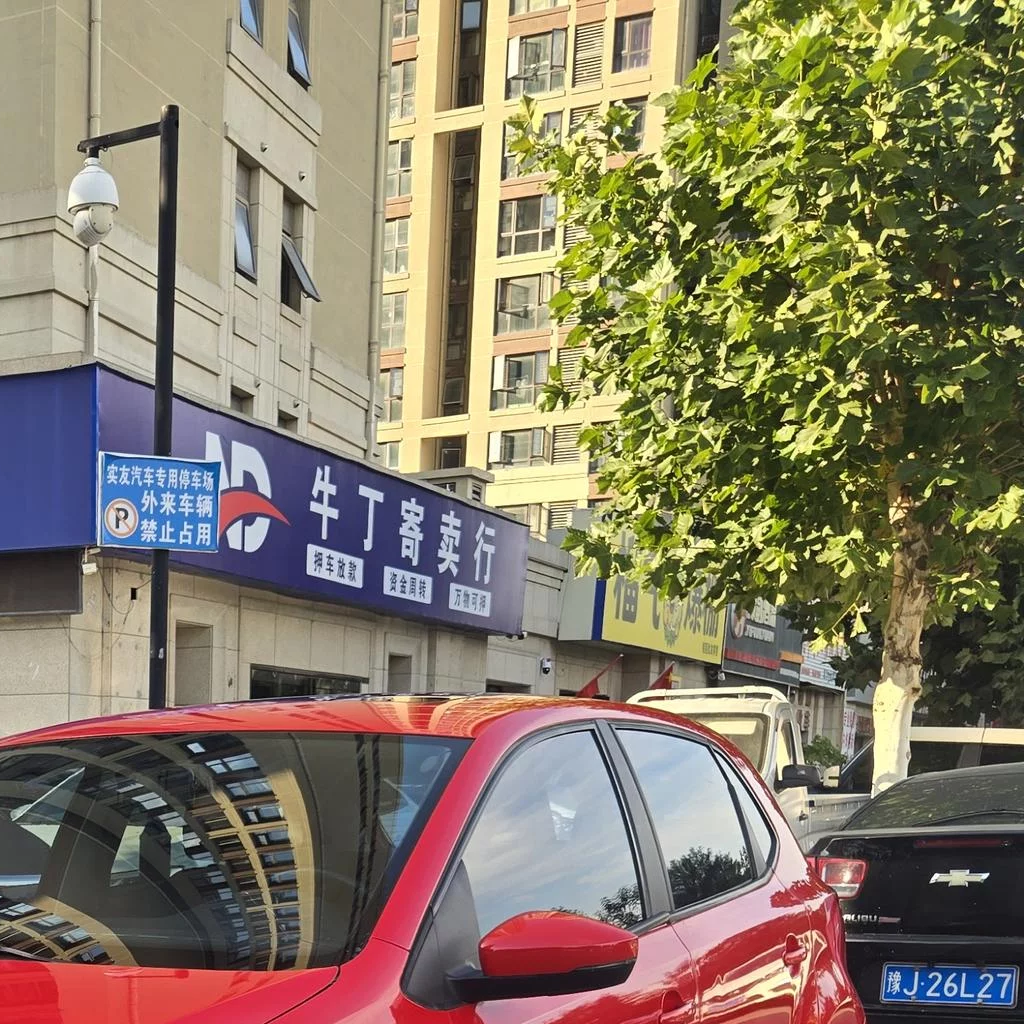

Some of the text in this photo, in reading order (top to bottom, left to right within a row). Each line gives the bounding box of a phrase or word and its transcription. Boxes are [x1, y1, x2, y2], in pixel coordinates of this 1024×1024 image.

[106, 464, 215, 492] 实友汽车专用停车场
[141, 490, 214, 518] 外来车辆
[140, 519, 212, 546] 禁止占用
[309, 465, 497, 585] 牛丁寄卖行
[313, 550, 358, 583] 押车放款
[389, 571, 428, 600] 资金周转
